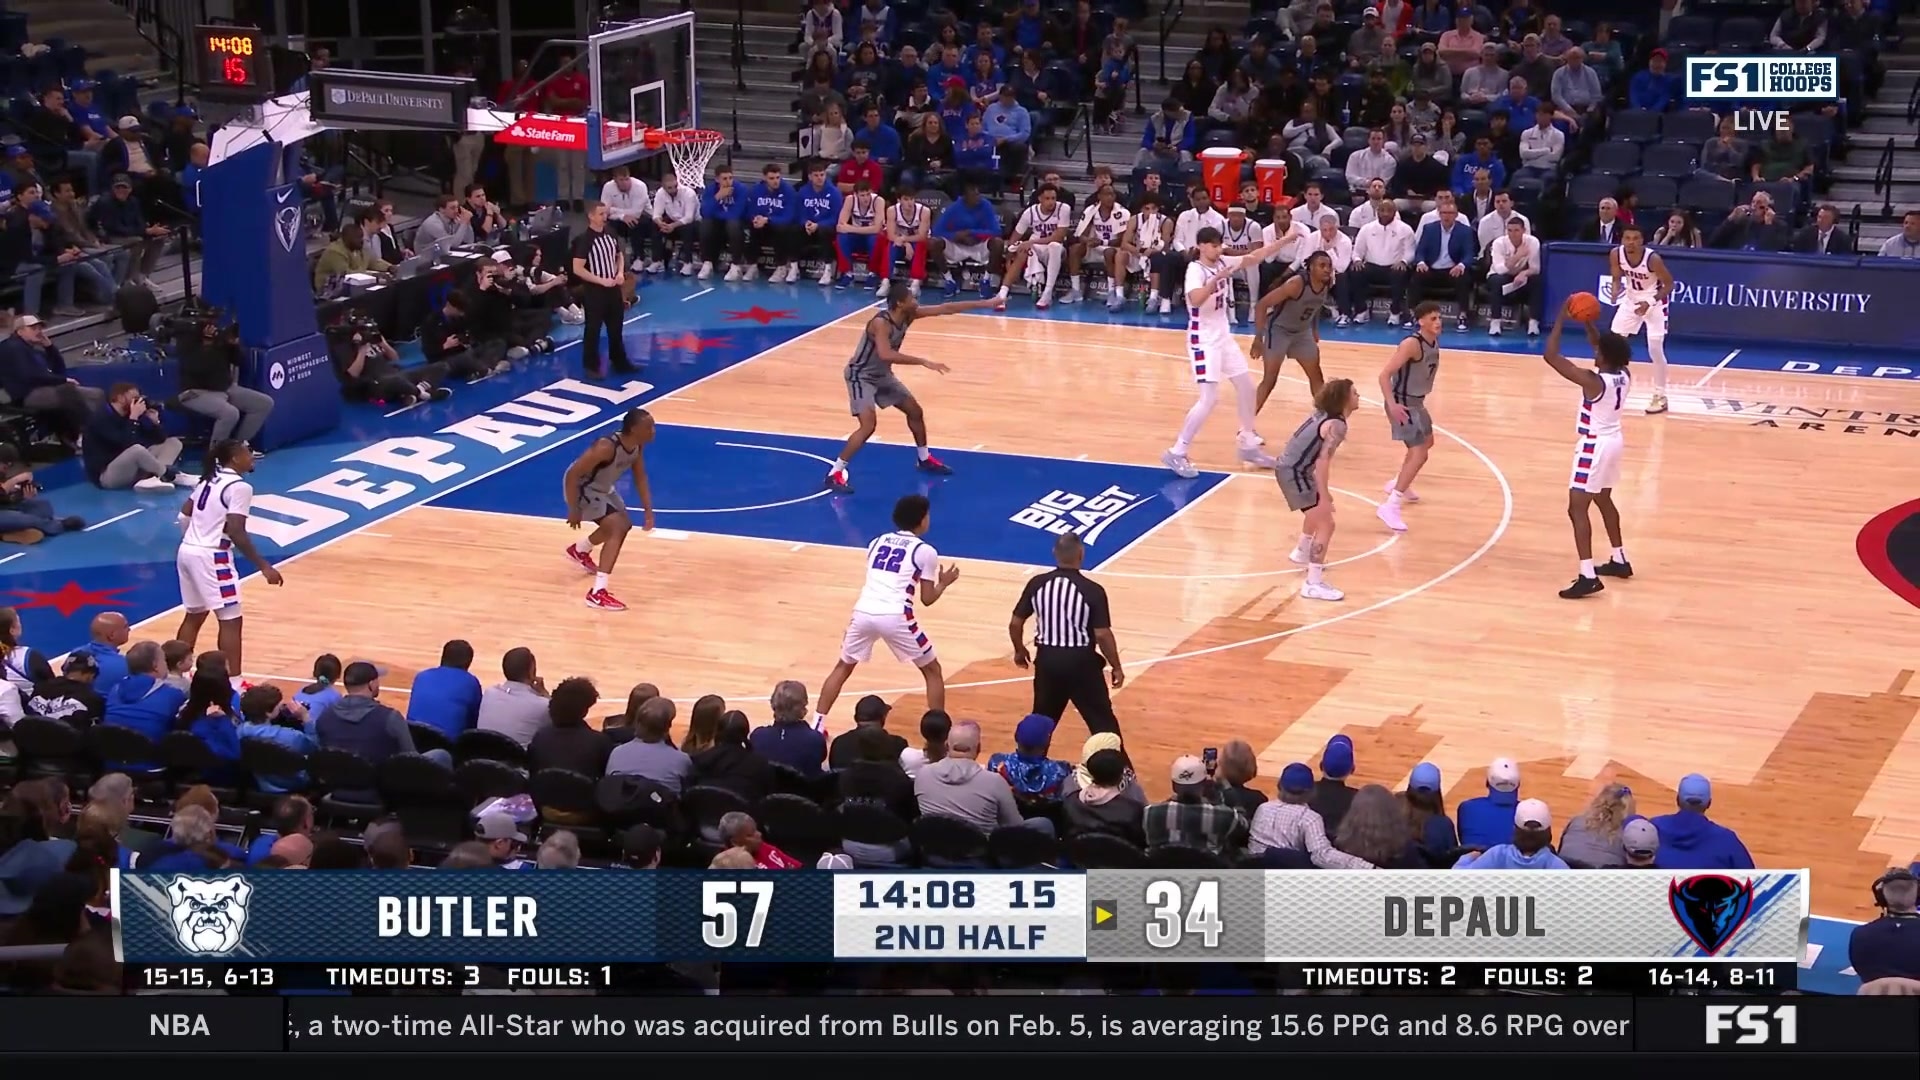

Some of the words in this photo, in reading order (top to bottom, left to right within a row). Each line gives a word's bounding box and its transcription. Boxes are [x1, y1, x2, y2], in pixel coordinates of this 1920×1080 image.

[209, 36, 253, 55] 14:08
[223, 57, 246, 82] 15
[386, 93, 445, 109] UNIVERSITY
[1631, 278, 1644, 291] 11
[1671, 281, 1723, 305] PAUL
[1728, 284, 1871, 313] UNIVERSITY
[1301, 308, 1314, 321] 5
[287, 352, 312, 365] MIDWEST
[1428, 363, 1437, 378] 7
[1781, 361, 1920, 378] DEP
[1614, 387, 1621, 411] 1
[246, 378, 654, 548] DEPAUL
[197, 485, 211, 511] 0
[1009, 489, 1086, 529] BIG
[1044, 485, 1137, 535] EAST
[872, 545, 906, 573] 22
